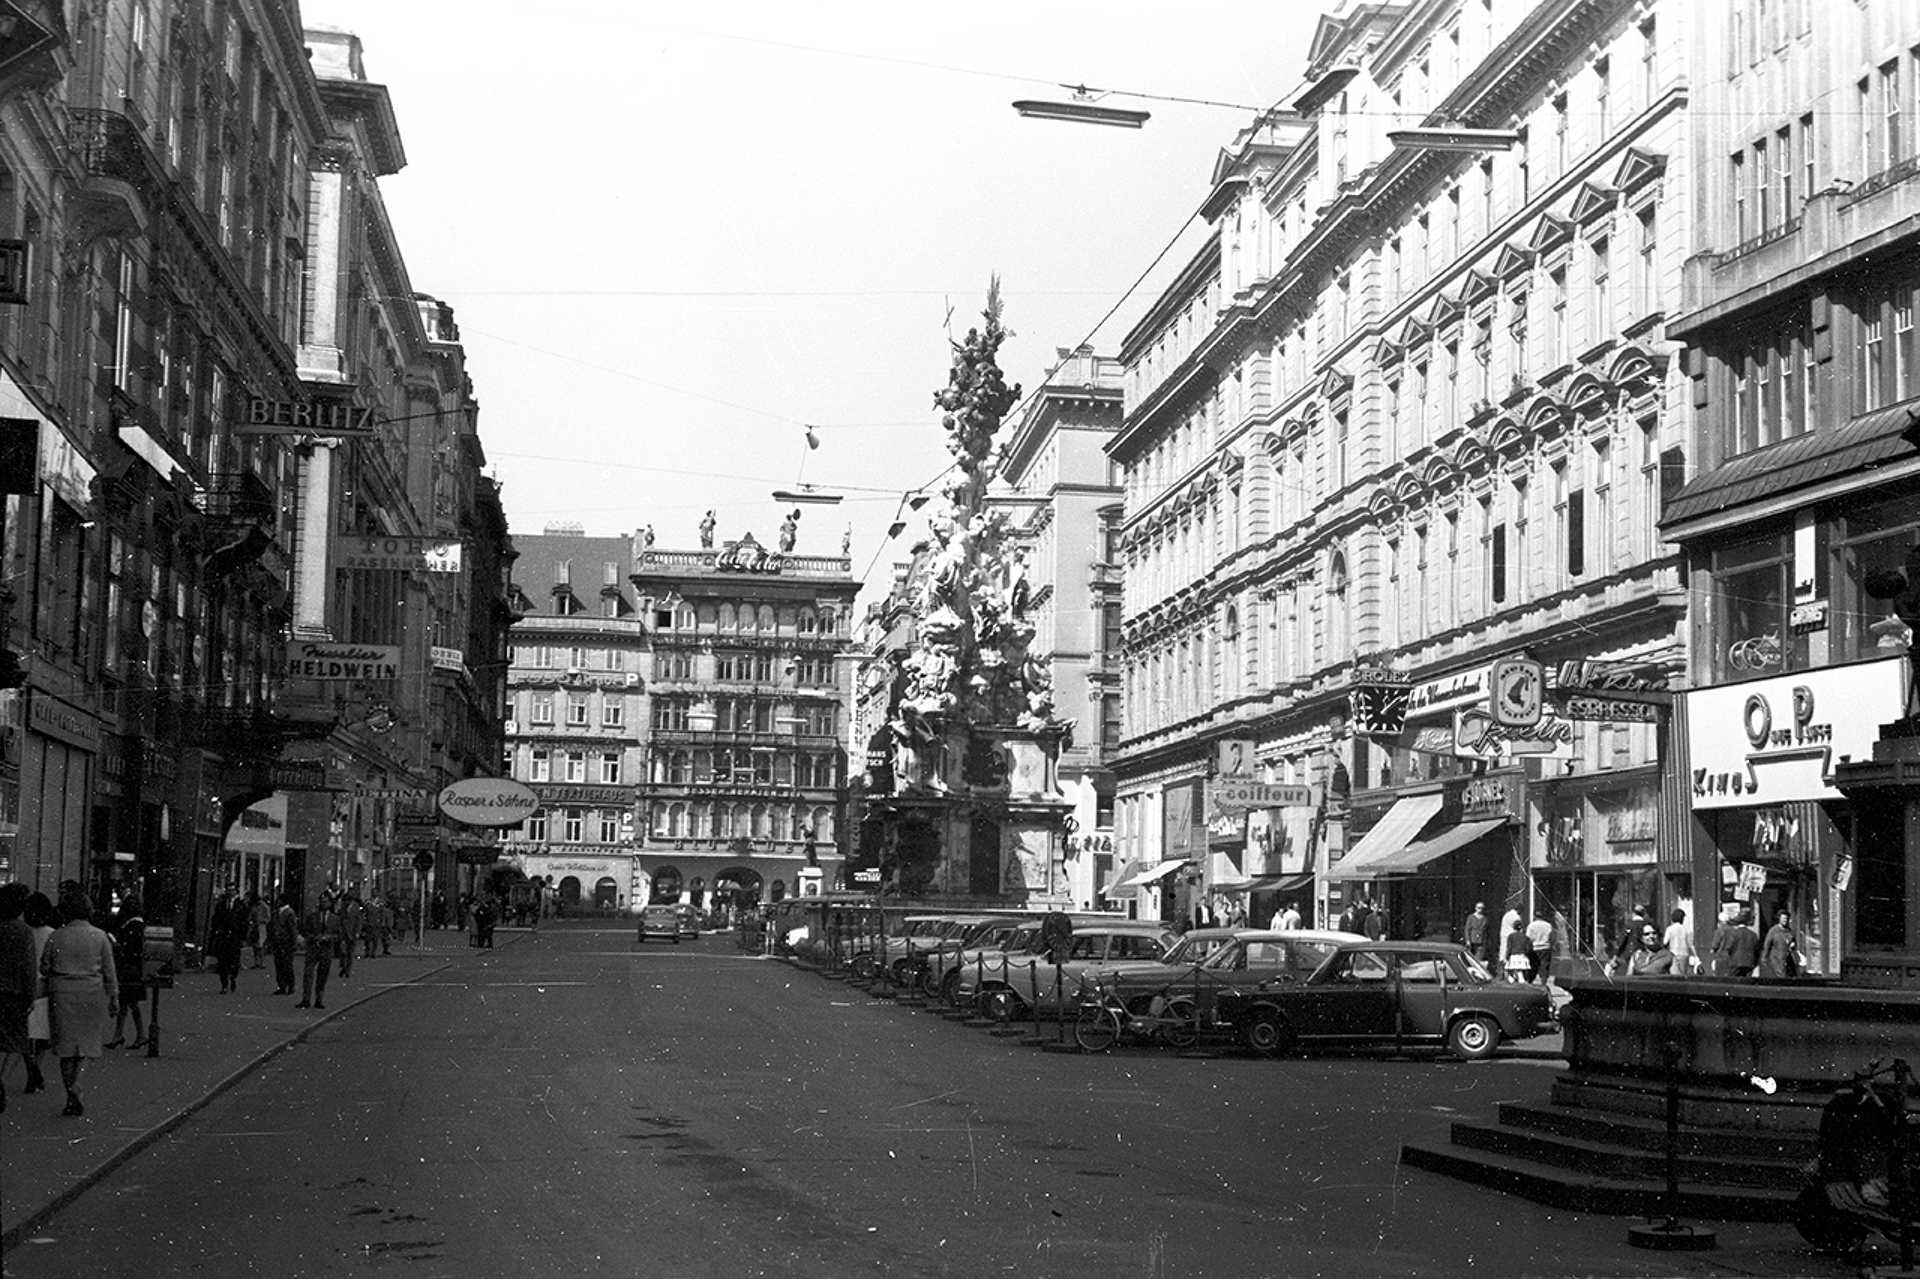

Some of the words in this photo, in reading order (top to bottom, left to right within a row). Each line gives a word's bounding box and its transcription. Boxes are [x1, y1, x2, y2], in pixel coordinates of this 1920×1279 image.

[249, 399, 374, 429] BERLITZ
[289, 660, 397, 679] HELDWEIN
[1362, 671, 1412, 684] ROLEX
[1567, 698, 1650, 717] ESPRESSO
[1692, 768, 1743, 798] KINO
[1226, 786, 1304, 801] coiffeur
